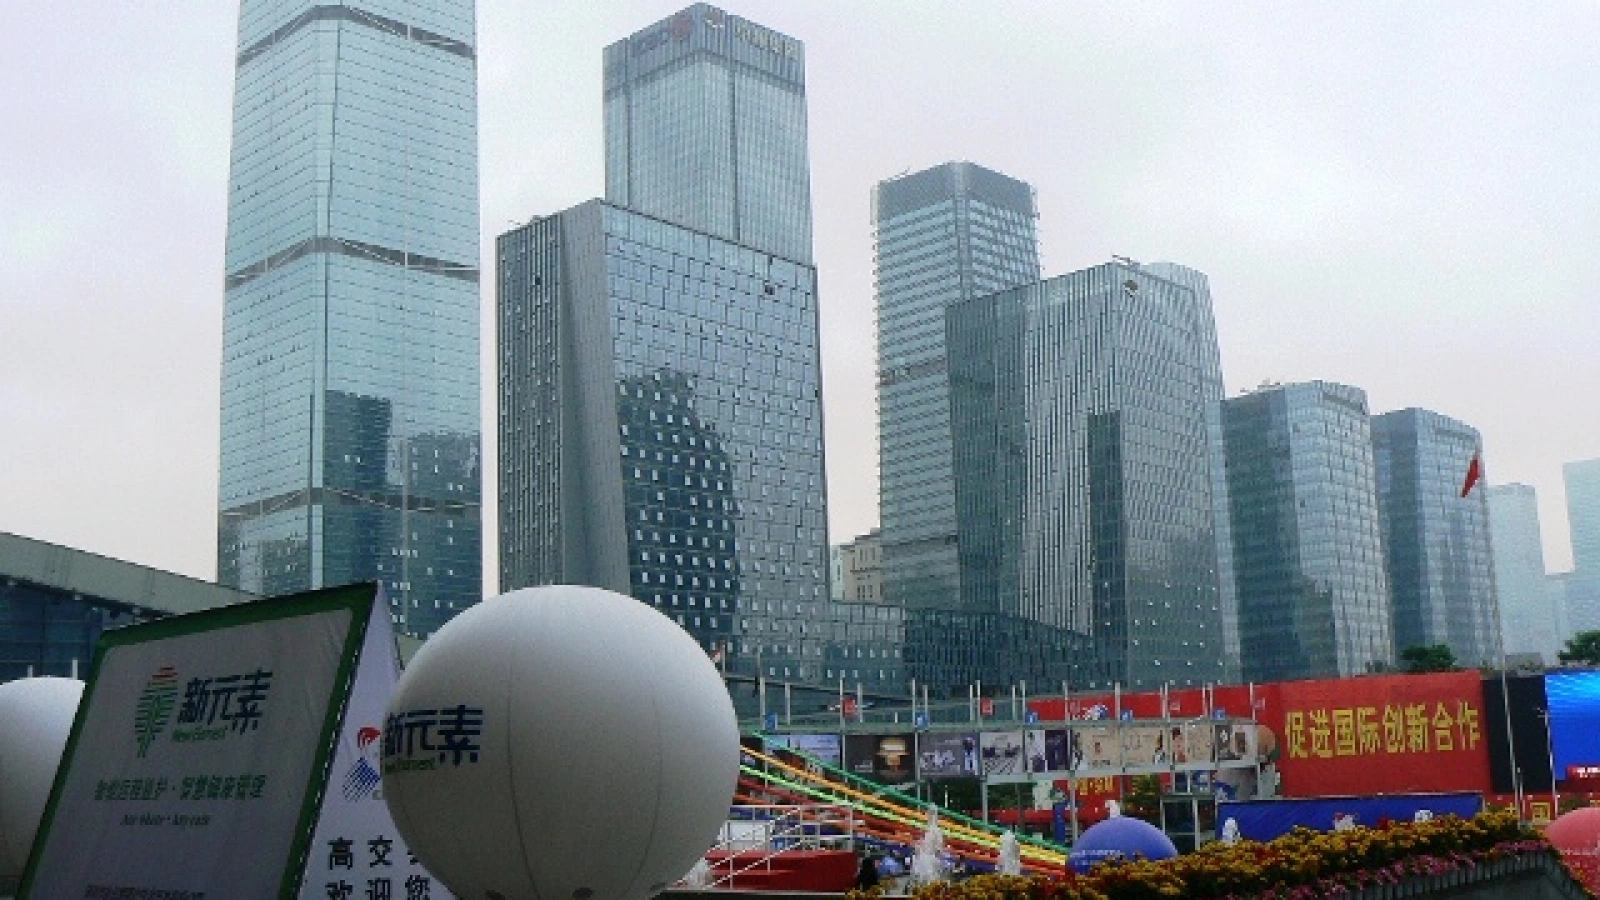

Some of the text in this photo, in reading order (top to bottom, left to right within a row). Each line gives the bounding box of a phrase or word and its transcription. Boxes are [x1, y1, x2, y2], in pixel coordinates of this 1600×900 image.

[177, 668, 272, 735] 新元素
[1285, 701, 1480, 758] 促进国际创新合作
[327, 835, 420, 871] 高交
